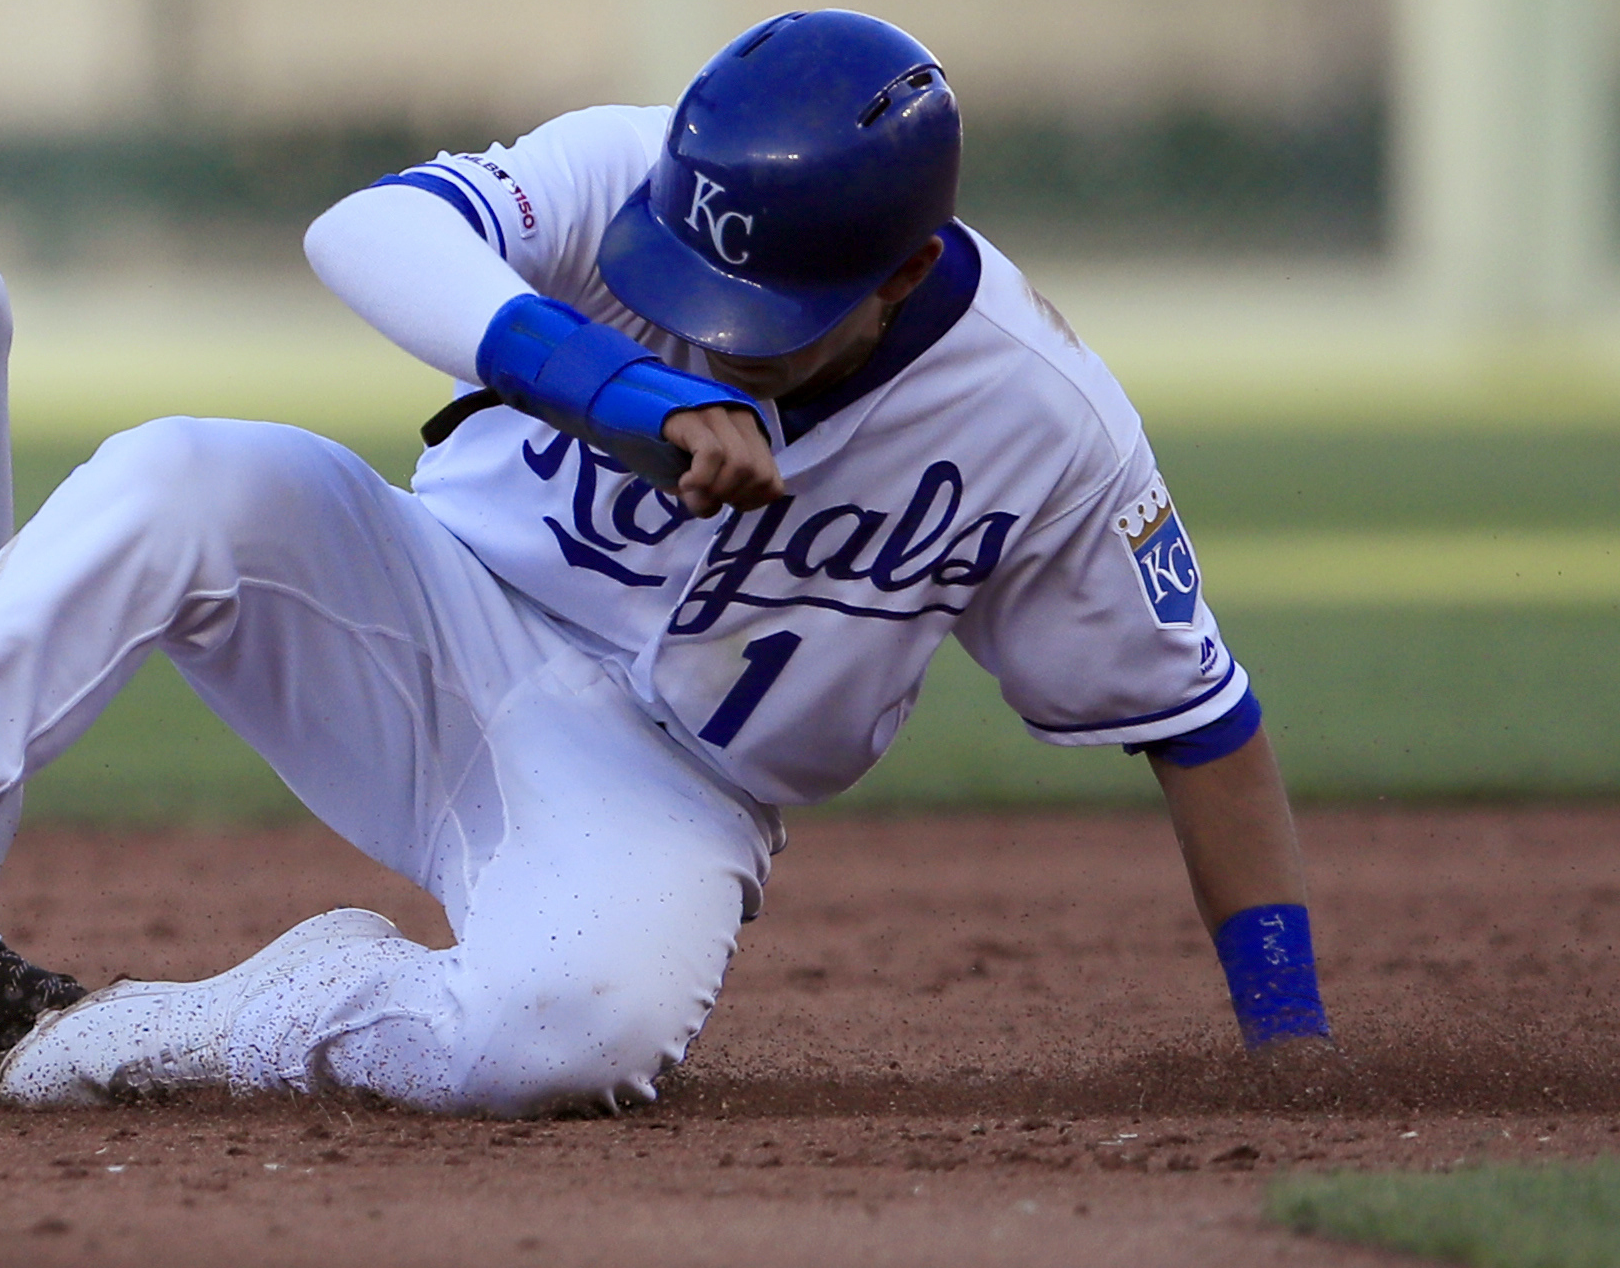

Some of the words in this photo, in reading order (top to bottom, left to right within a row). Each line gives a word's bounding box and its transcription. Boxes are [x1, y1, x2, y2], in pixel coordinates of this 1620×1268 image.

[514, 192, 535, 230] 150
[684, 170, 753, 264] KC
[1140, 537, 1196, 604] KC
[698, 630, 802, 749] 1
